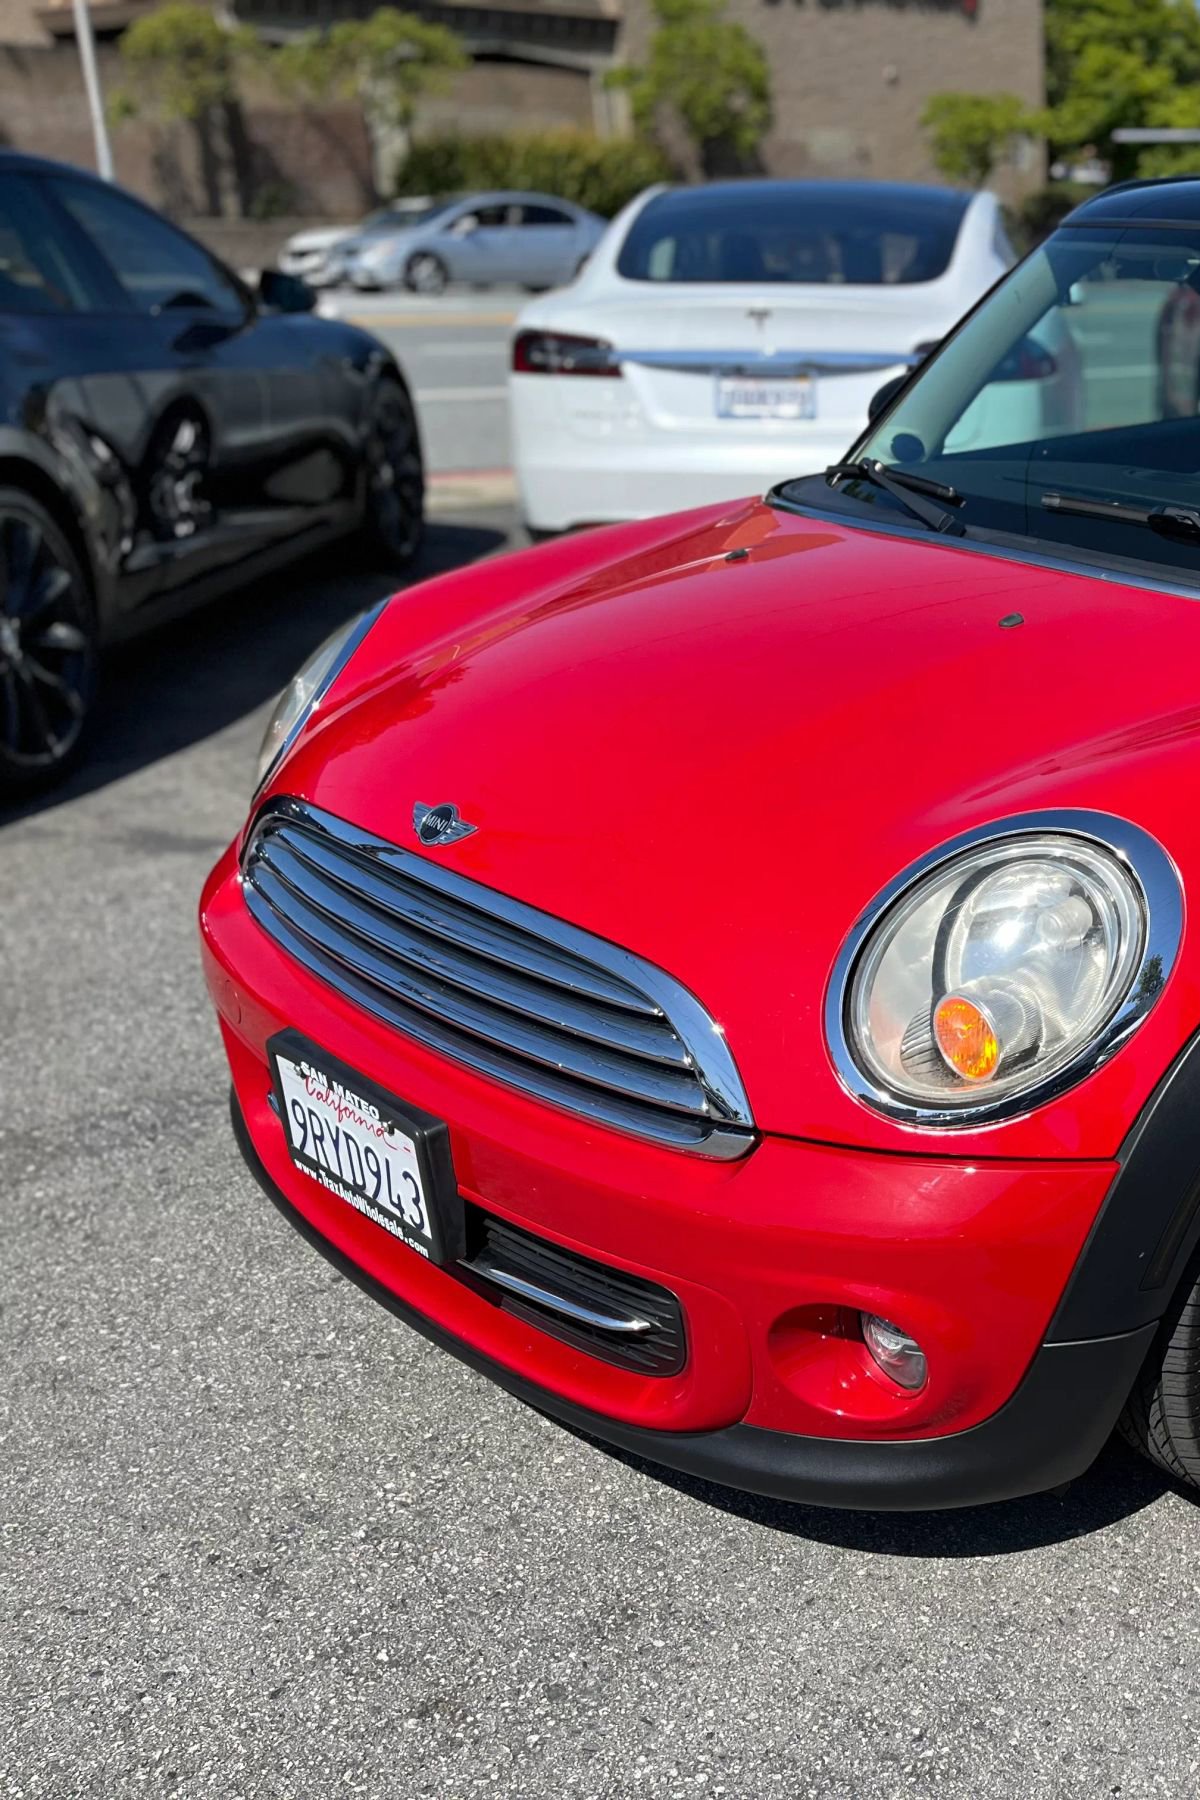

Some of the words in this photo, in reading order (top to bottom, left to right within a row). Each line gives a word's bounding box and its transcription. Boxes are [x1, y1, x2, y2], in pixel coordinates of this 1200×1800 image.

[426, 814, 449, 831] MINI
[300, 1061, 328, 1087] SAN
[331, 1080, 379, 1120] MATEO
[304, 1075, 397, 1150] California
[291, 1098, 424, 1231] 9RYD943
